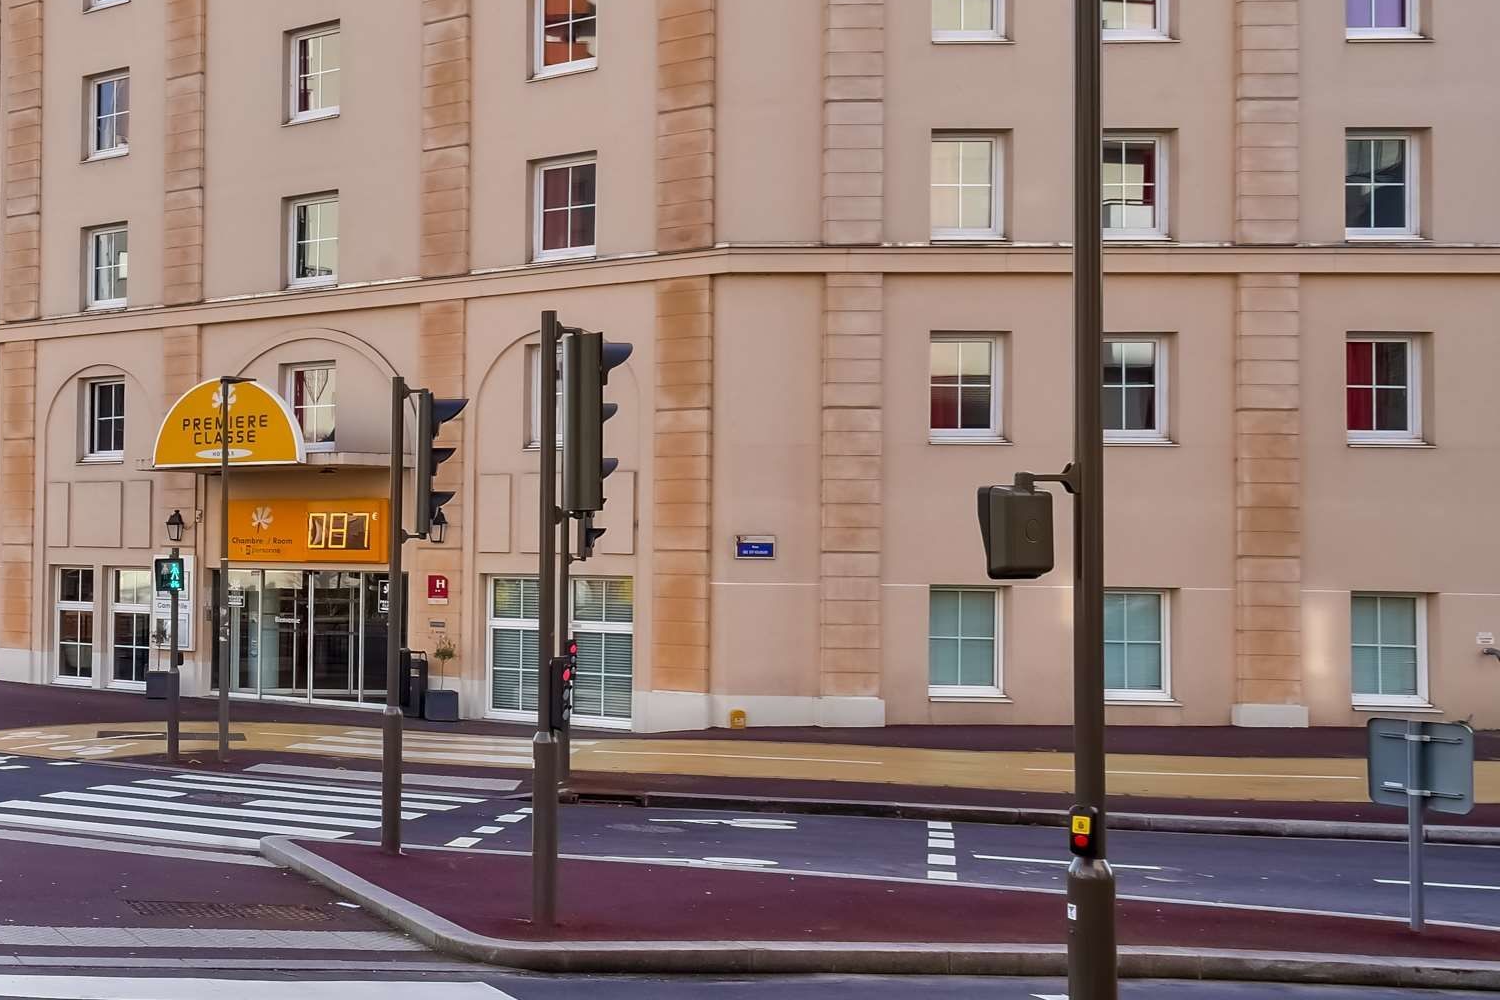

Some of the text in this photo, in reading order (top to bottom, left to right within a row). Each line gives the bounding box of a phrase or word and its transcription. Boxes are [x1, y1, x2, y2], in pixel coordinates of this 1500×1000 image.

[193, 430, 256, 445] CLASSE
[231, 536, 263, 545] Chambre
[273, 537, 293, 545] Room
[436, 579, 445, 589] H
